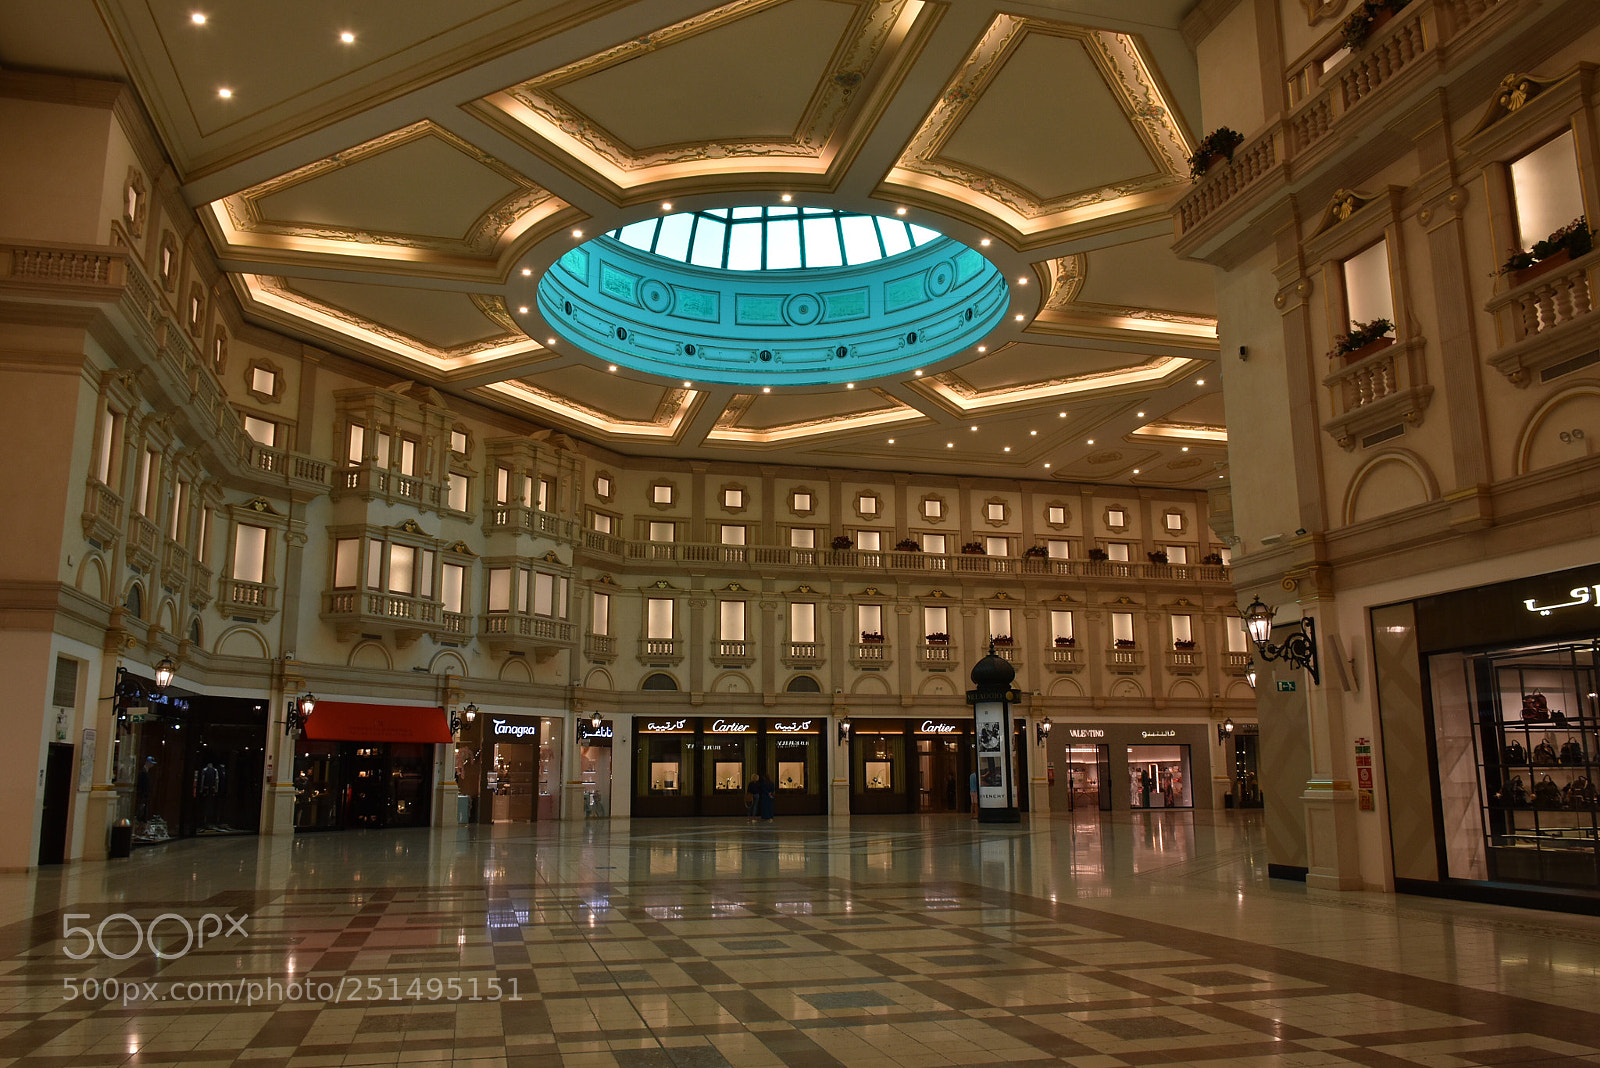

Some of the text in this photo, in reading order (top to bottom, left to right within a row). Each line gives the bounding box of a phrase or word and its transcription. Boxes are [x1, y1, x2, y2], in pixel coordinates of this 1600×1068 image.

[493, 719, 536, 738] Tanagra
[647, 719, 687, 732] كارتييه
[712, 719, 750, 732] Cartier
[774, 720, 812, 732] كارتييه
[921, 720, 956, 732] Cartier
[1069, 729, 1104, 738] VALENTINO
